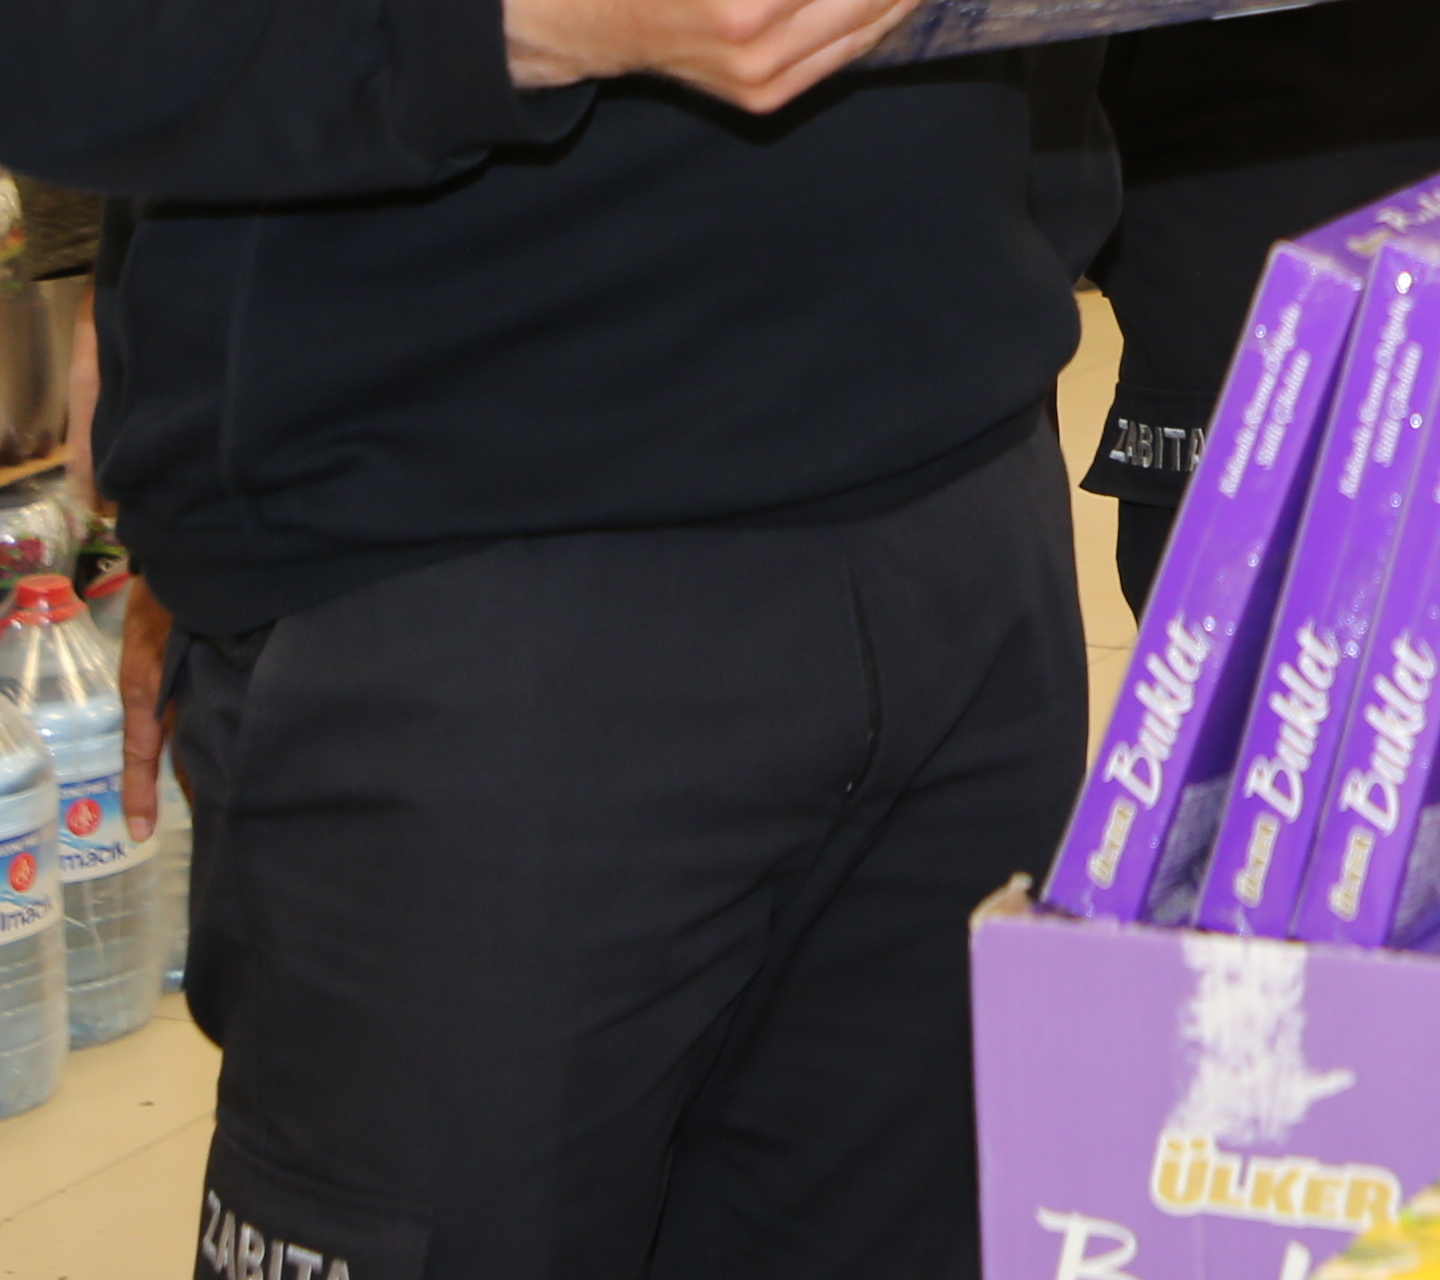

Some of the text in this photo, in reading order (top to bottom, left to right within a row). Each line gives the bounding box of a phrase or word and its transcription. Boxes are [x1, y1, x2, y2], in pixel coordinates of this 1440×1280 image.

[1109, 418, 1207, 472] ZABITA
[1103, 611, 1211, 810] Buklet
[1244, 620, 1341, 824] Buklet
[1338, 630, 1438, 838] Buklet
[60, 841, 128, 871] macık
[1150, 1133, 1401, 1234] ÜLKER
